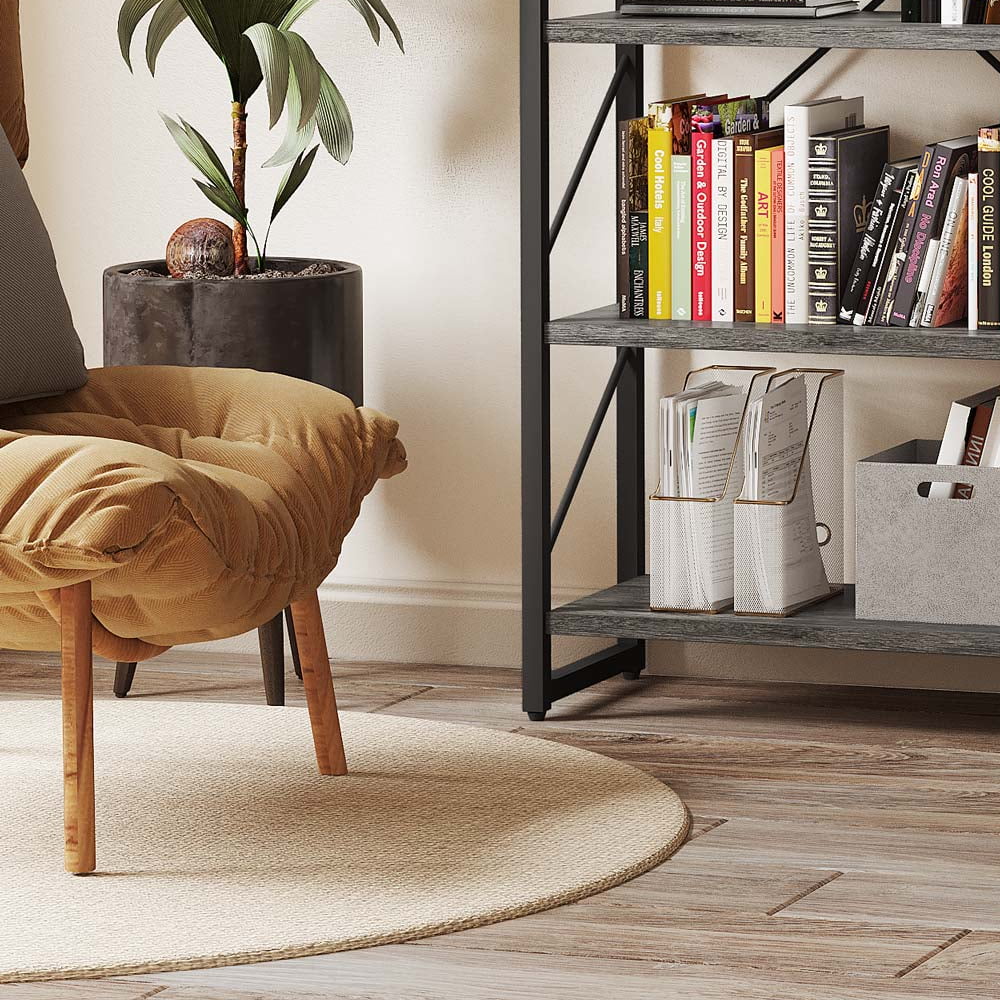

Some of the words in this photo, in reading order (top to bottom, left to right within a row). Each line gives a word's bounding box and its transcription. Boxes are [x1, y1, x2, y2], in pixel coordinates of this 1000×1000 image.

[654, 149, 665, 173] Cool
[696, 139, 707, 178] Garden
[717, 140, 727, 179] DIGITAL
[932, 156, 947, 178] Ron
[654, 175, 665, 209] Hotels
[696, 181, 706, 189] &
[718, 186, 728, 197] BY
[740, 178, 748, 193] The
[925, 180, 940, 208] Arad
[982, 168, 995, 201] COOL
[696, 192, 707, 238] Outdoor
[739, 194, 748, 232] Godfather
[757, 192, 769, 218] ART
[631, 216, 639, 247] MAXWELL
[639, 222, 647, 242] JAMES
[652, 216, 664, 233] Italy
[718, 204, 728, 240] DESIGN
[787, 220, 795, 241] LIFE
[919, 213, 932, 230] No
[982, 205, 995, 241] GUIDE
[694, 241, 707, 276] Design
[738, 235, 748, 260] Family
[904, 232, 928, 284] Discipline
[740, 261, 748, 284] Album
[787, 248, 795, 293] UNCOMMON
[982, 245, 993, 287] London
[633, 269, 644, 316] ENCHANTRESS
[787, 300, 795, 315] THE
